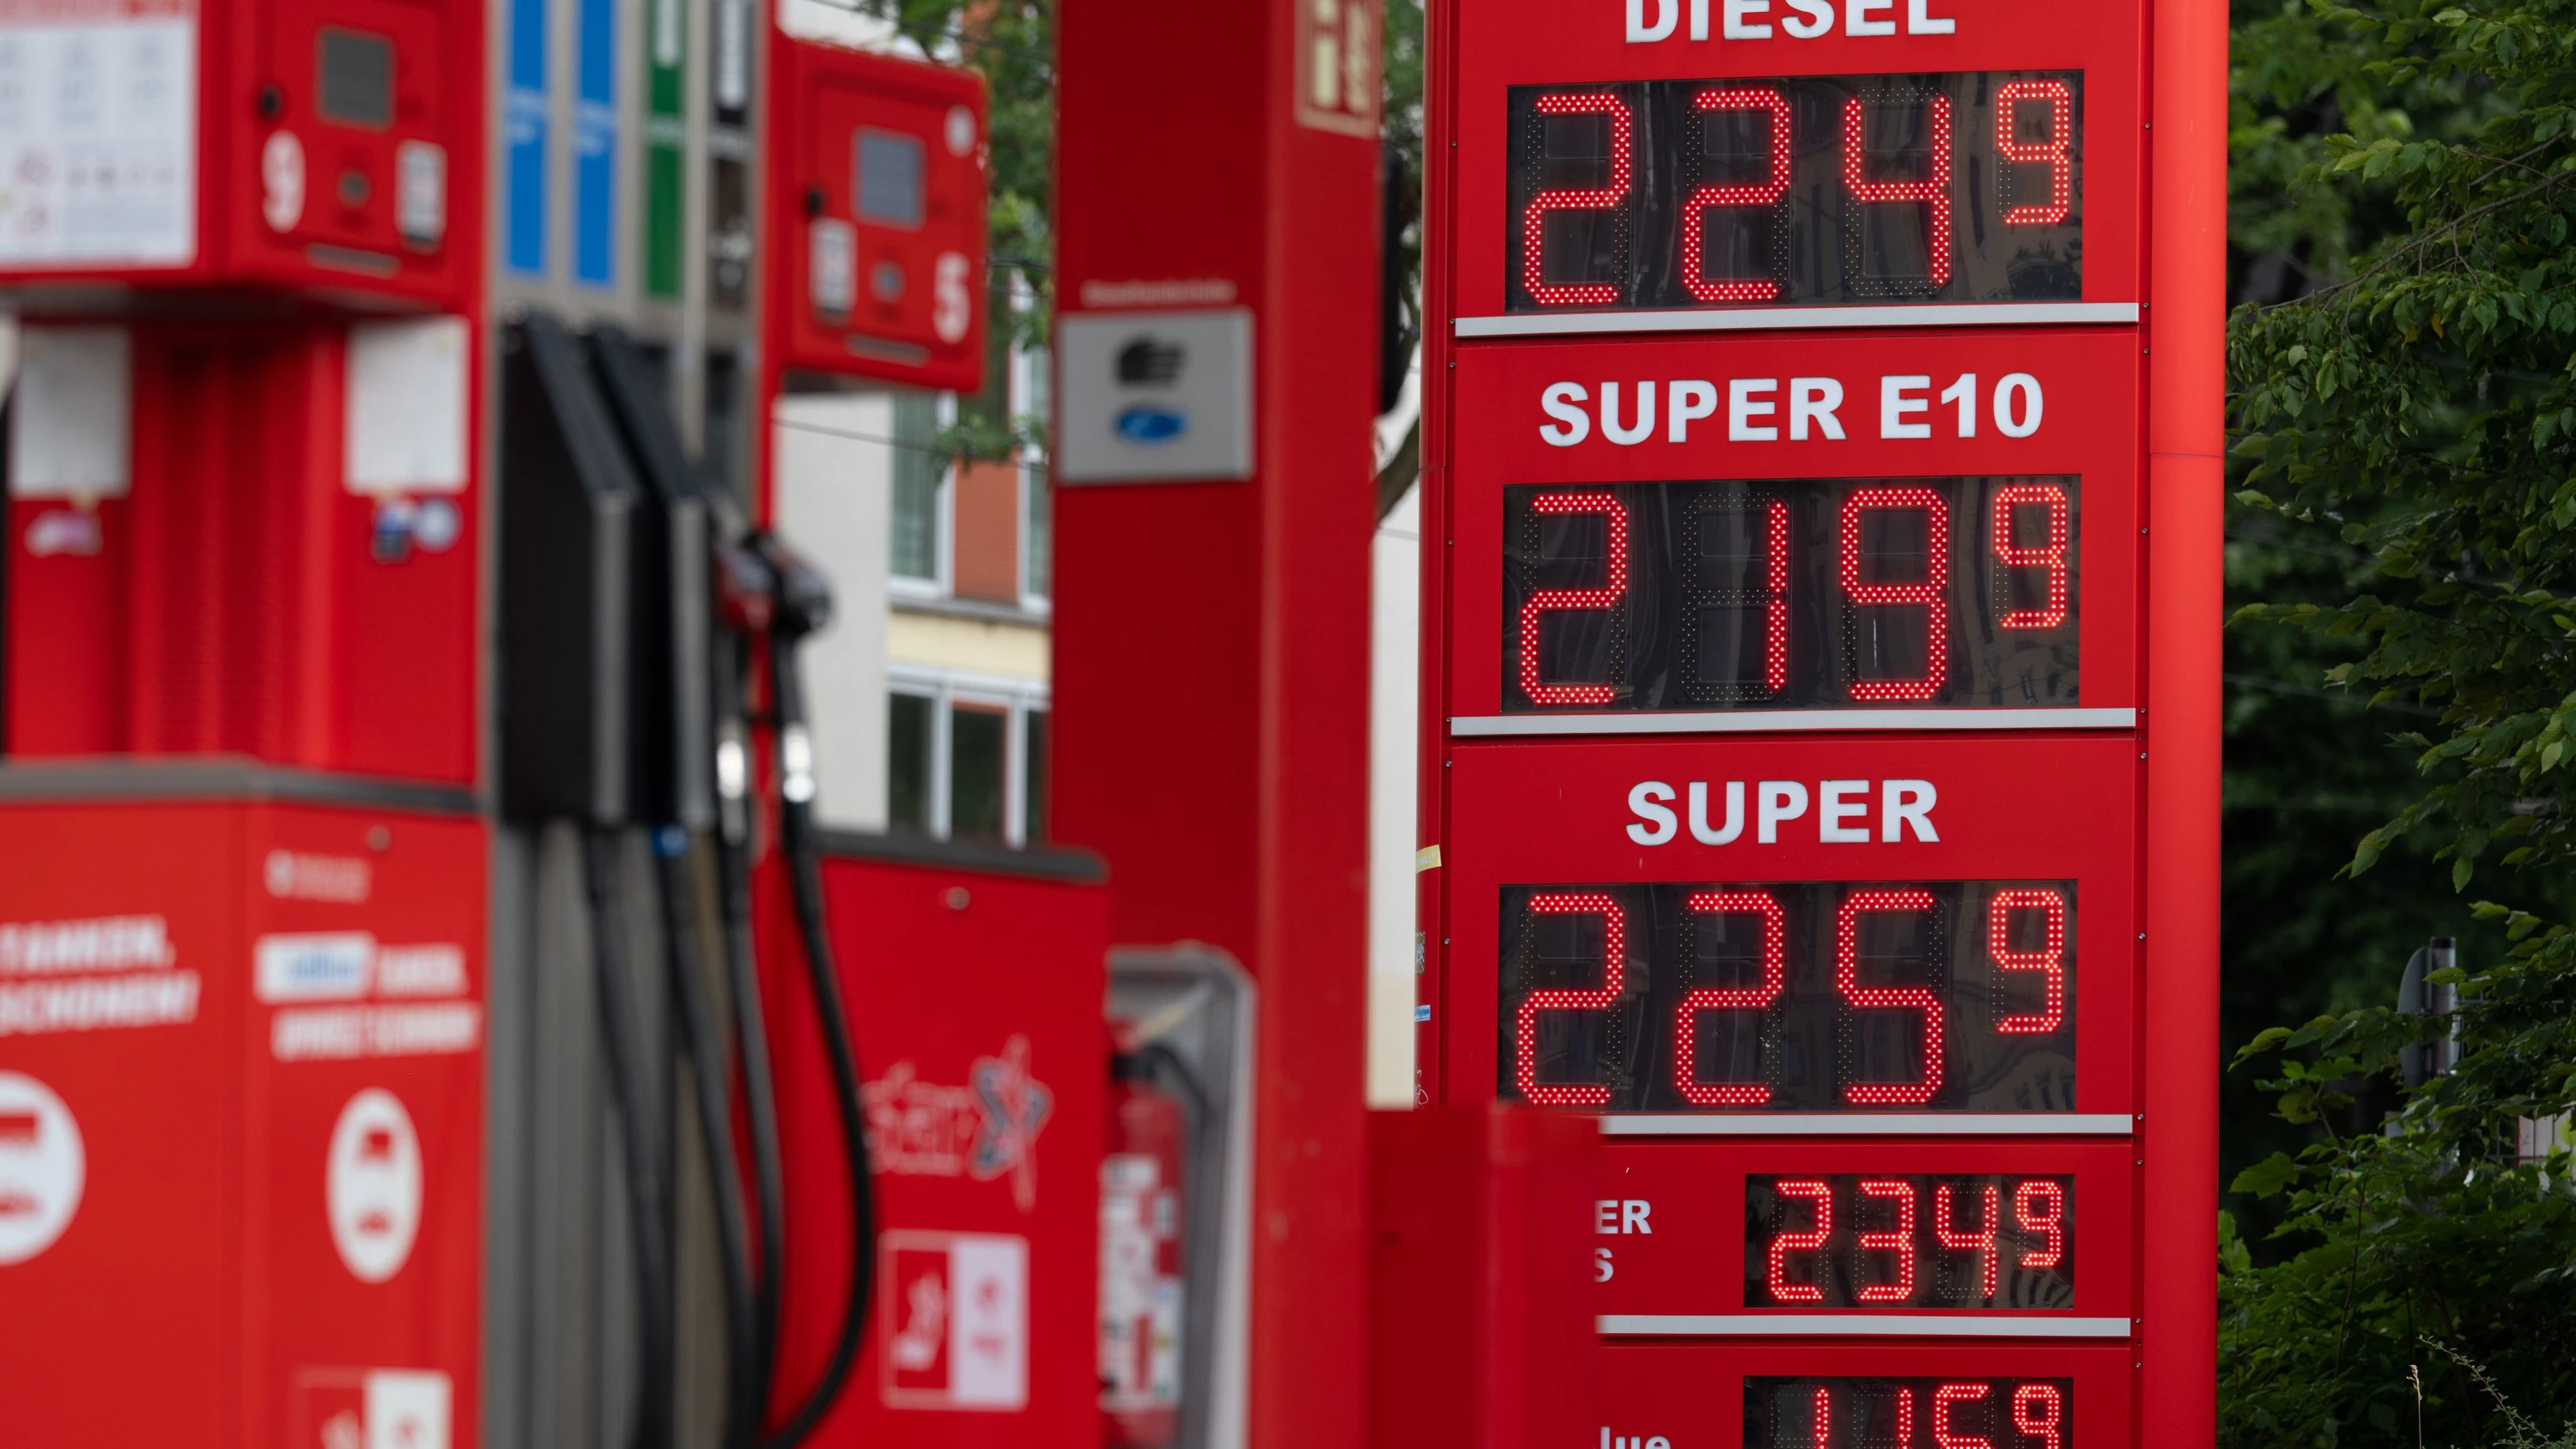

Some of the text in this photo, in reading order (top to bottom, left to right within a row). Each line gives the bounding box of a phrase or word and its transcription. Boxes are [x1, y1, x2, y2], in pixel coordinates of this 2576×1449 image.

[1625, 0, 1956, 43] DIESEL
[1539, 373, 2044, 447] SUPER E10
[1625, 779, 1940, 846] SUPER
